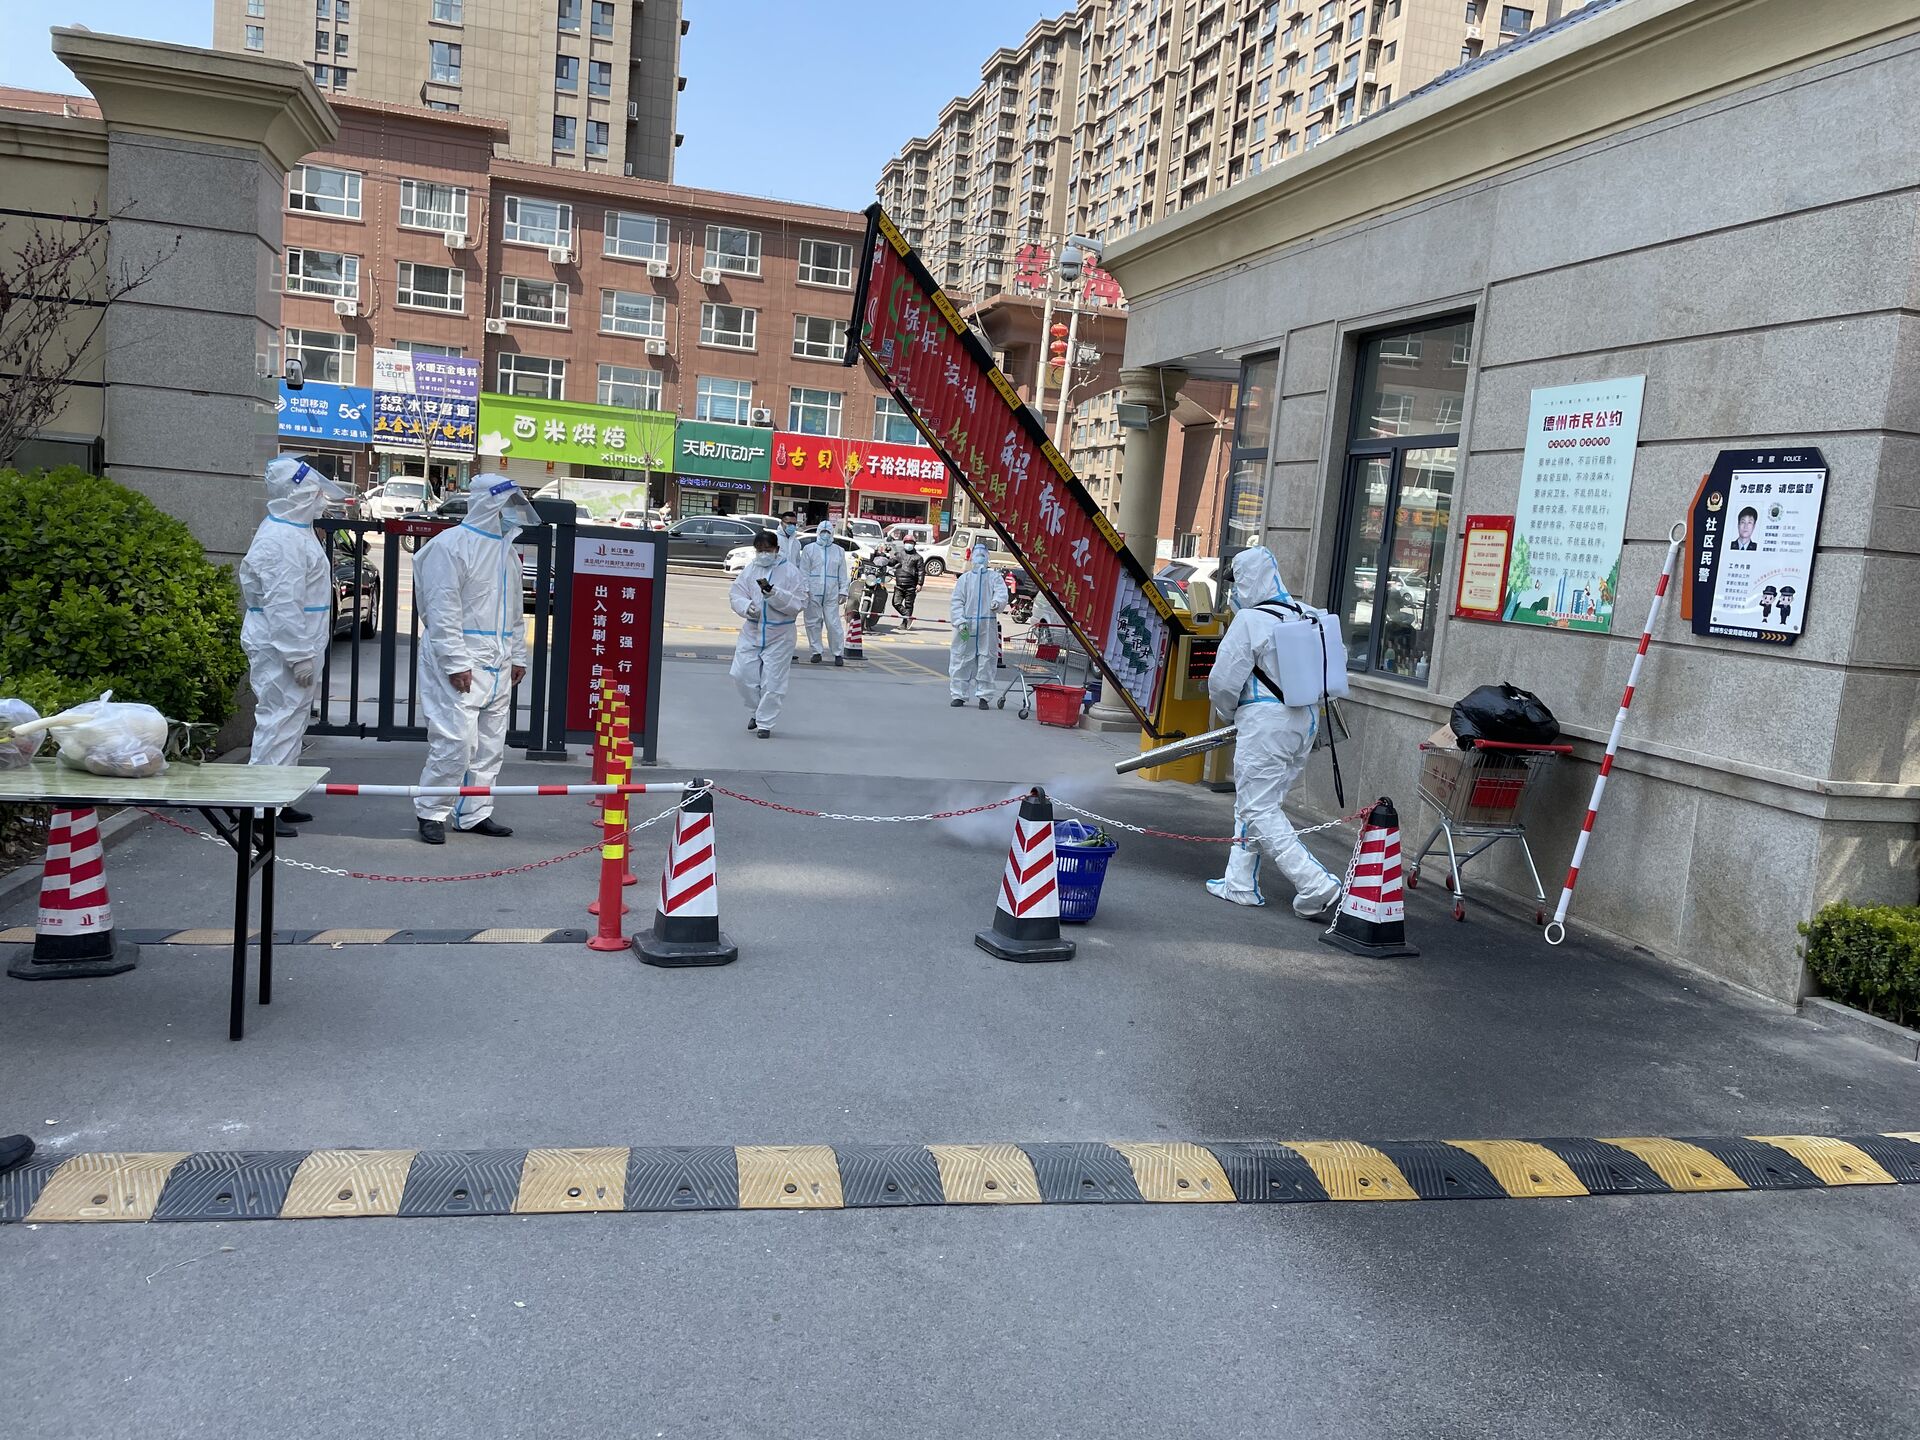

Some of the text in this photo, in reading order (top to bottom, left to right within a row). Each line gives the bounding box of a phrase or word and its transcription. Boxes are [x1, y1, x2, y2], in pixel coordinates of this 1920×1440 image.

[415, 361, 478, 378] 水暖五金电料
[290, 397, 329, 409] 中国移动
[290, 406, 329, 416] China Mobile
[513, 414, 626, 449] 西米烘焙
[1543, 409, 1623, 432] 德州市民公约
[682, 439, 765, 462] 天悦不动产
[866, 455, 945, 481] 子裕名烟名酒
[1739, 482, 1814, 494] 为您服务 请您监督
[1698, 516, 1718, 583] 社区民警
[592, 585, 608, 656] 出入请刷卡
